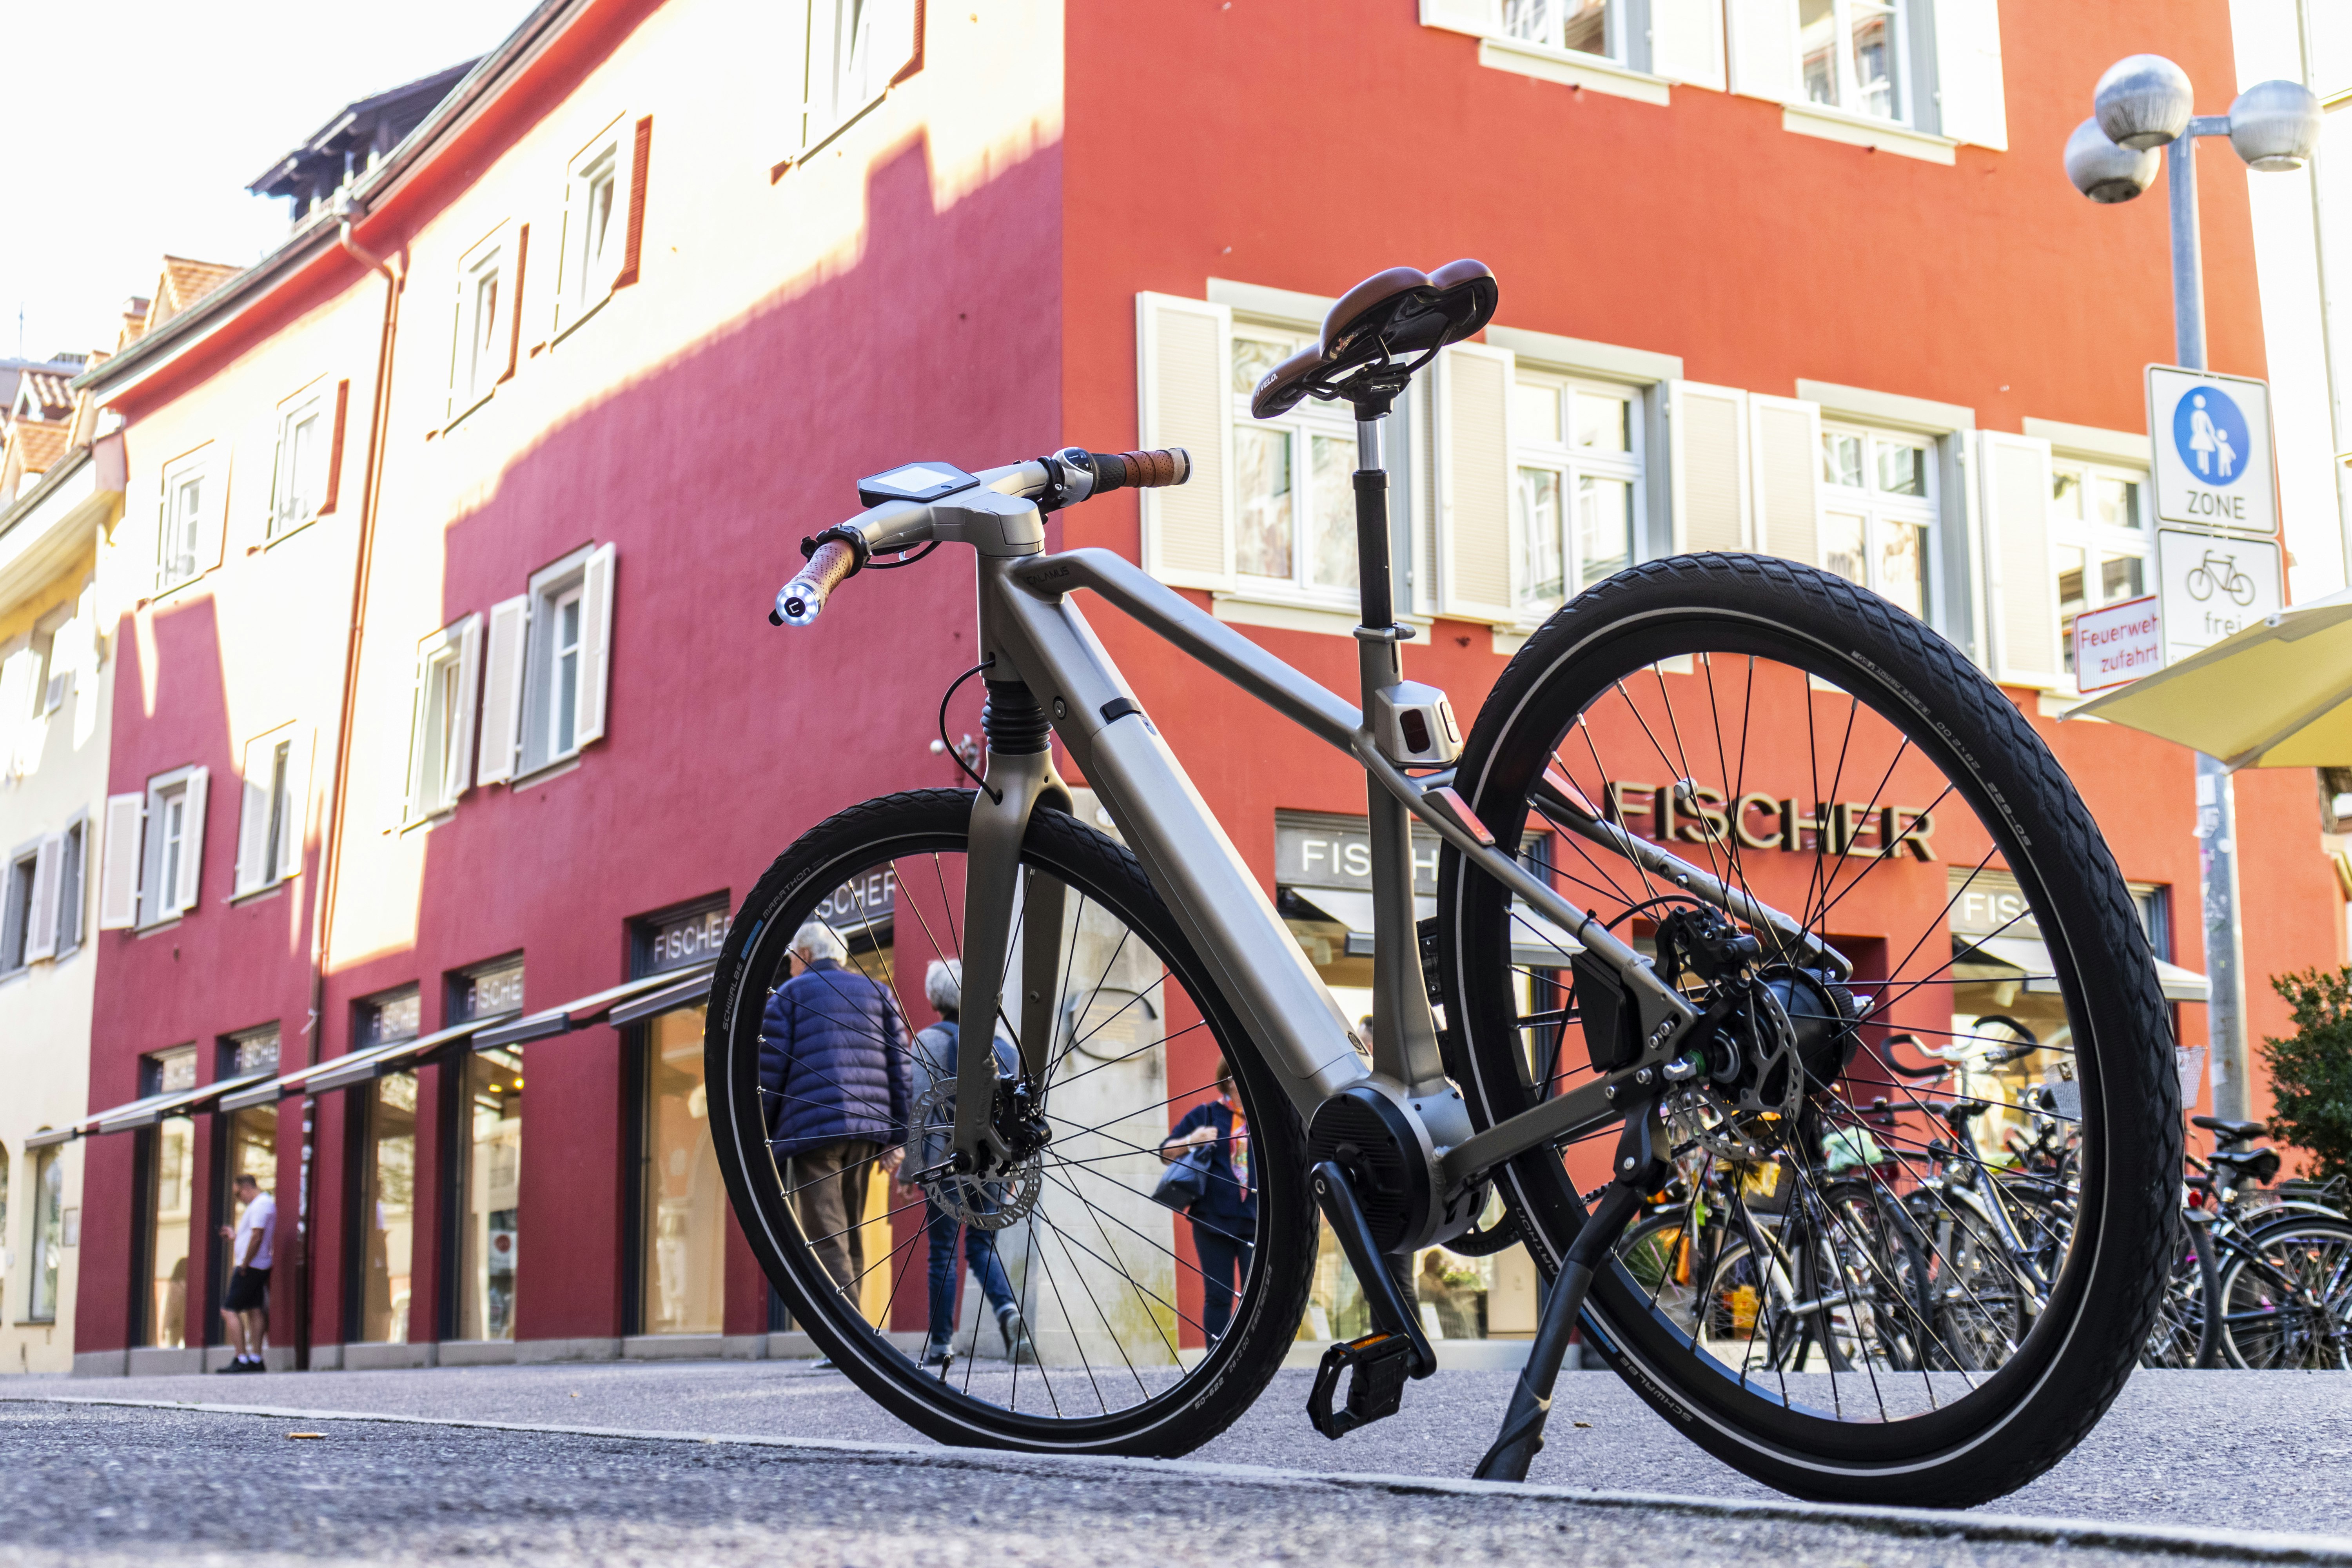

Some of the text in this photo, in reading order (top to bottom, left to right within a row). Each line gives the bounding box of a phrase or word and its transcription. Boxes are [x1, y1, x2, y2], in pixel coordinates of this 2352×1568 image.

[2187, 490, 2246, 520] ZONE
[1026, 566, 1070, 585] CALAMUS
[2205, 611, 2242, 636] frei
[2101, 644, 2158, 673] zufahrt
[1605, 781, 1939, 862] FISCHER
[1987, 782, 2032, 847] 50-622
[1302, 839, 1438, 882] FISH
[723, 867, 811, 1031] SCHWALBE MARATHON
[1516, 1207, 1693, 1422] SCHWALBE ARATHON
[1195, 1377, 1224, 1410] 50-622
